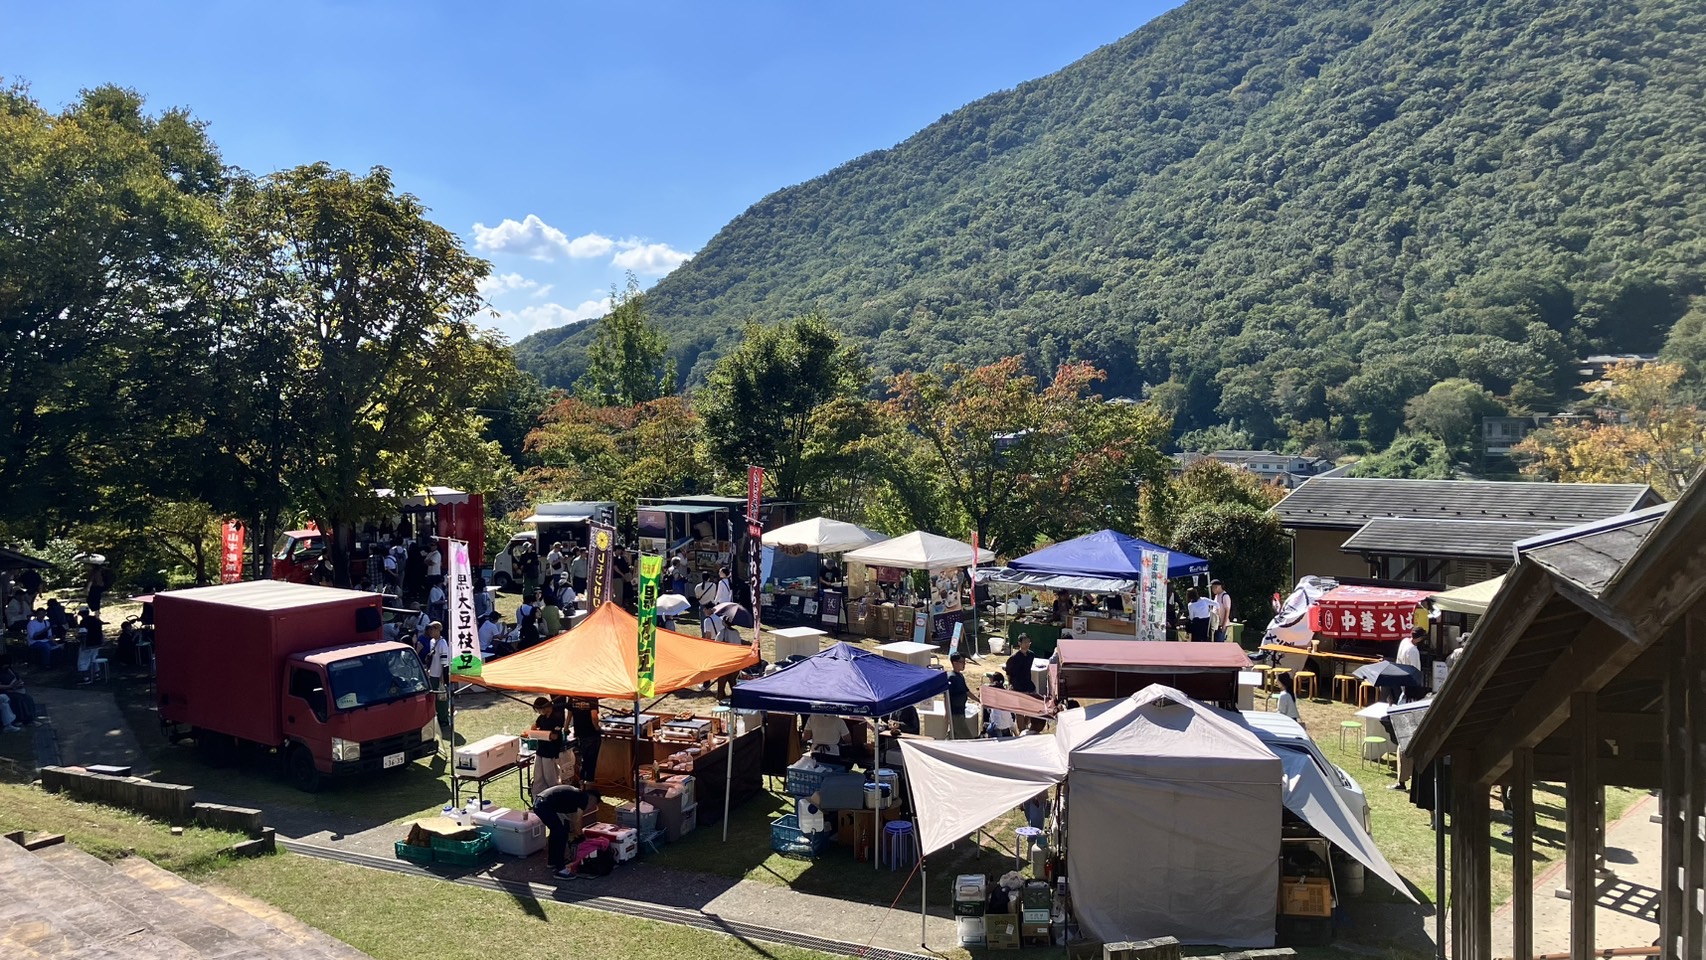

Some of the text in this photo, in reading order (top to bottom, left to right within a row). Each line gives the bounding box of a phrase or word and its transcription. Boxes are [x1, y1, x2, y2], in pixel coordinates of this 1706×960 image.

[456, 574, 475, 670] 黒大豆枝豆
[1341, 610, 1414, 633] 中華そば
